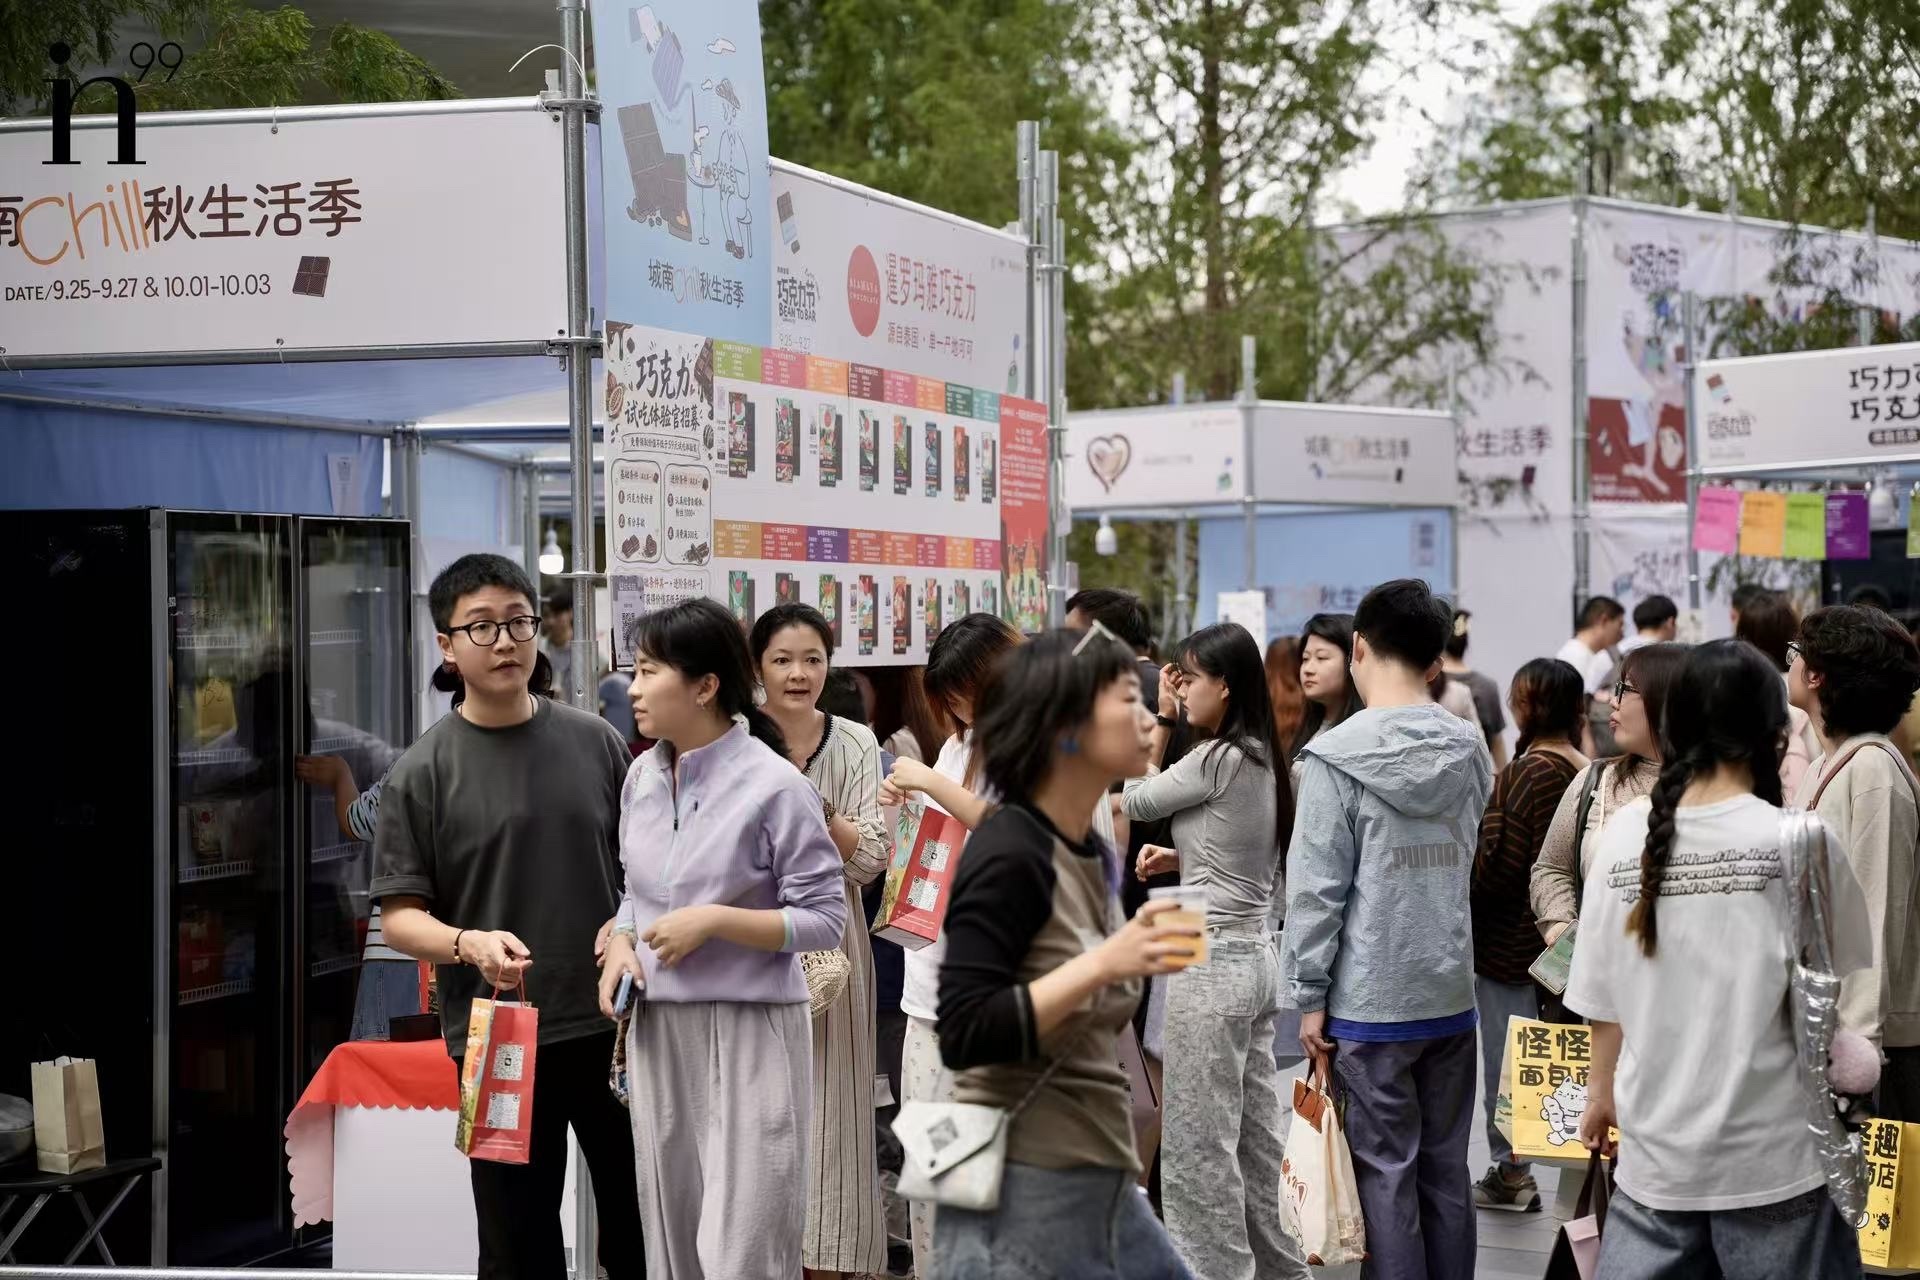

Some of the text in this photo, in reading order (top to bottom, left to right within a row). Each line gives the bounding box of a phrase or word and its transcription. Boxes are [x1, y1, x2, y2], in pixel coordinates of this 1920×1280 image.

[143, 279, 159, 298] &
[165, 273, 271, 298] 10.01-10.03
[777, 276, 815, 309] 巧克力节
[778, 302, 796, 318] BEAN
[804, 308, 817, 322] BAR
[636, 349, 691, 400] 巧克力
[624, 400, 700, 431] 试吃体验官招募
[1745, 847, 1781, 862] devil
[1687, 865, 1735, 880] wanted
[1696, 883, 1710, 894] to
[1711, 880, 1725, 893] be
[1725, 879, 1768, 894] found
[1517, 1026, 1591, 1062] 怪怪
